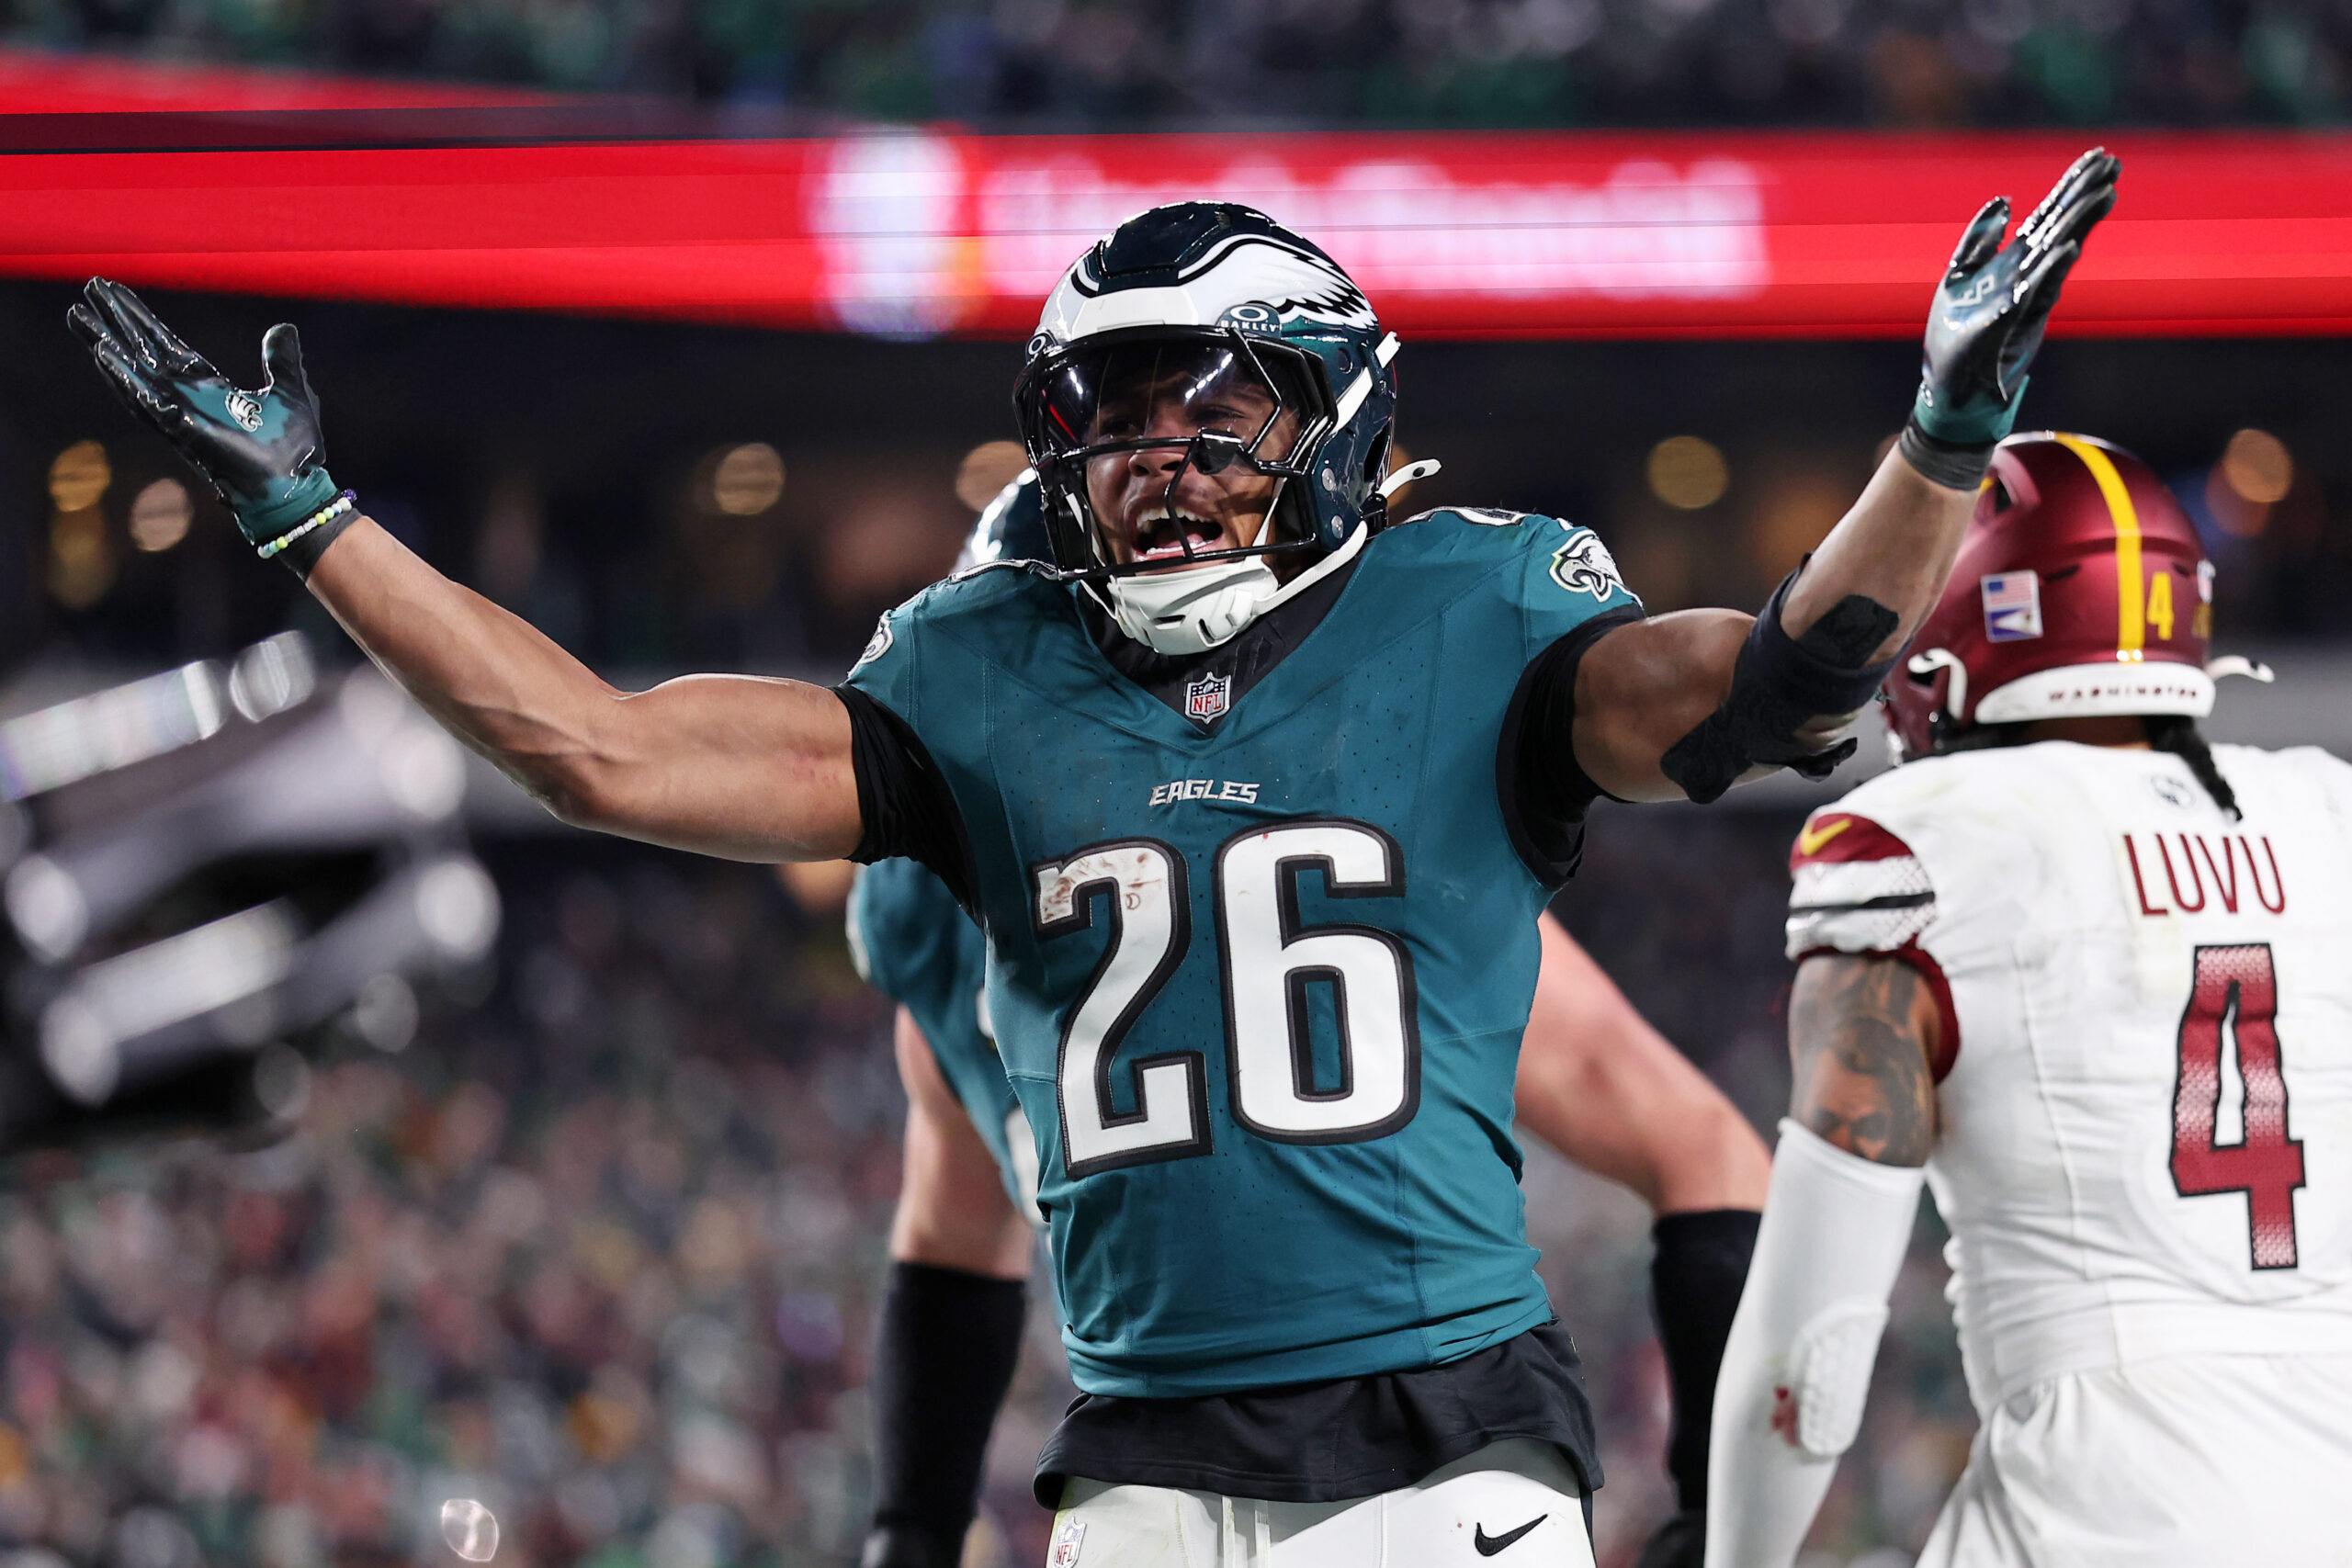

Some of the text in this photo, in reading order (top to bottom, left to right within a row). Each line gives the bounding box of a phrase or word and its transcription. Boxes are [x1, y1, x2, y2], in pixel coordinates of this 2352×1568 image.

[2147, 571, 2175, 640] 4
[1192, 694, 1222, 713] NFL
[1148, 779, 1261, 807] EAGLES
[2123, 833, 2286, 916] LUVU
[1031, 816, 1422, 1181] 26
[2169, 942, 2307, 1271] 4
[1056, 1543, 1074, 1565] NFL
